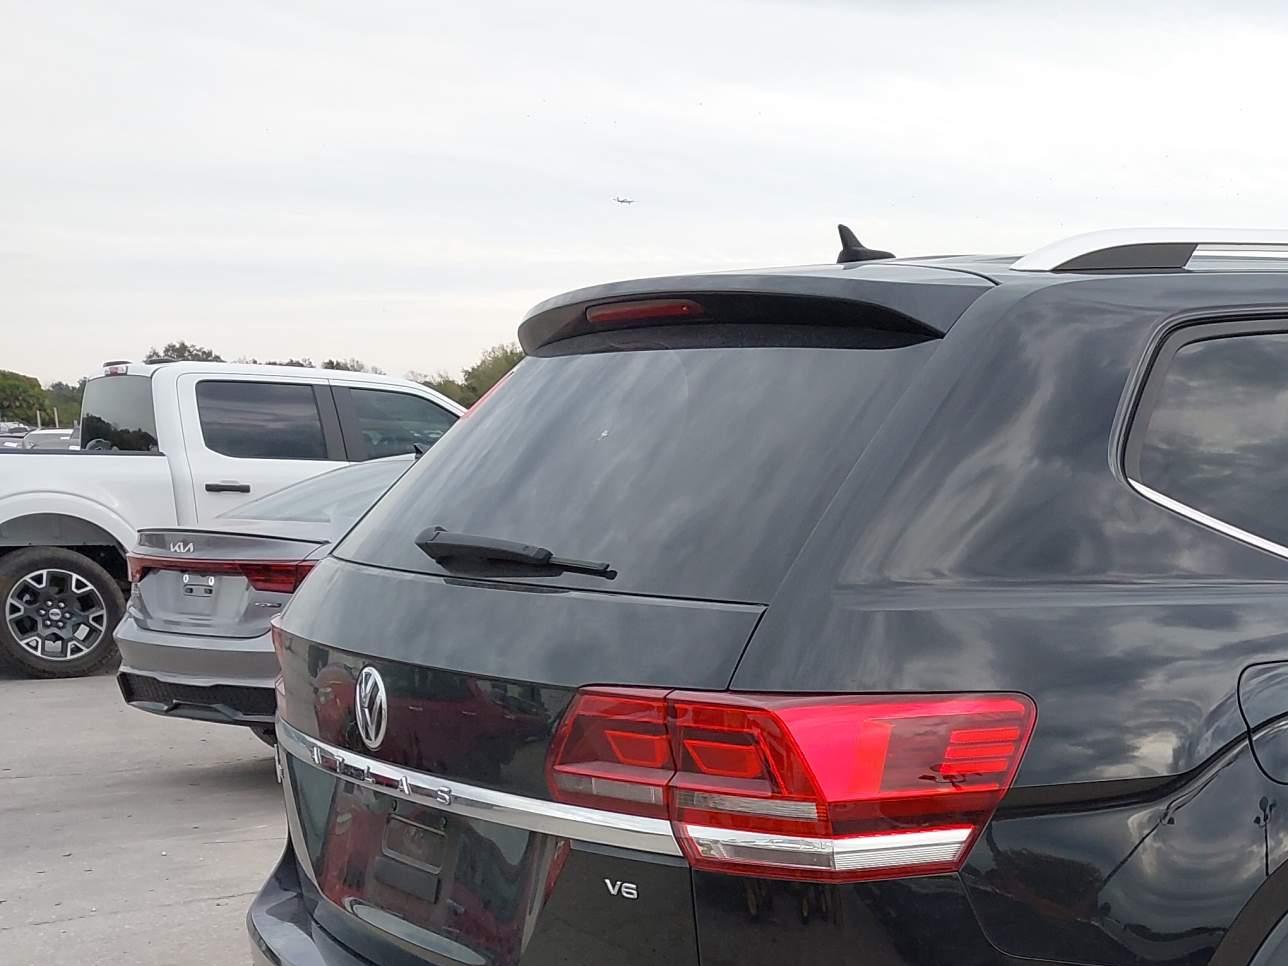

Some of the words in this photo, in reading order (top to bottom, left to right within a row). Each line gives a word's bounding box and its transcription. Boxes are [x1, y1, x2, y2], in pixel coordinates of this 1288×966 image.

[170, 542, 194, 553] KIA
[312, 746, 452, 806] ATLAS
[604, 878, 638, 899] V6
